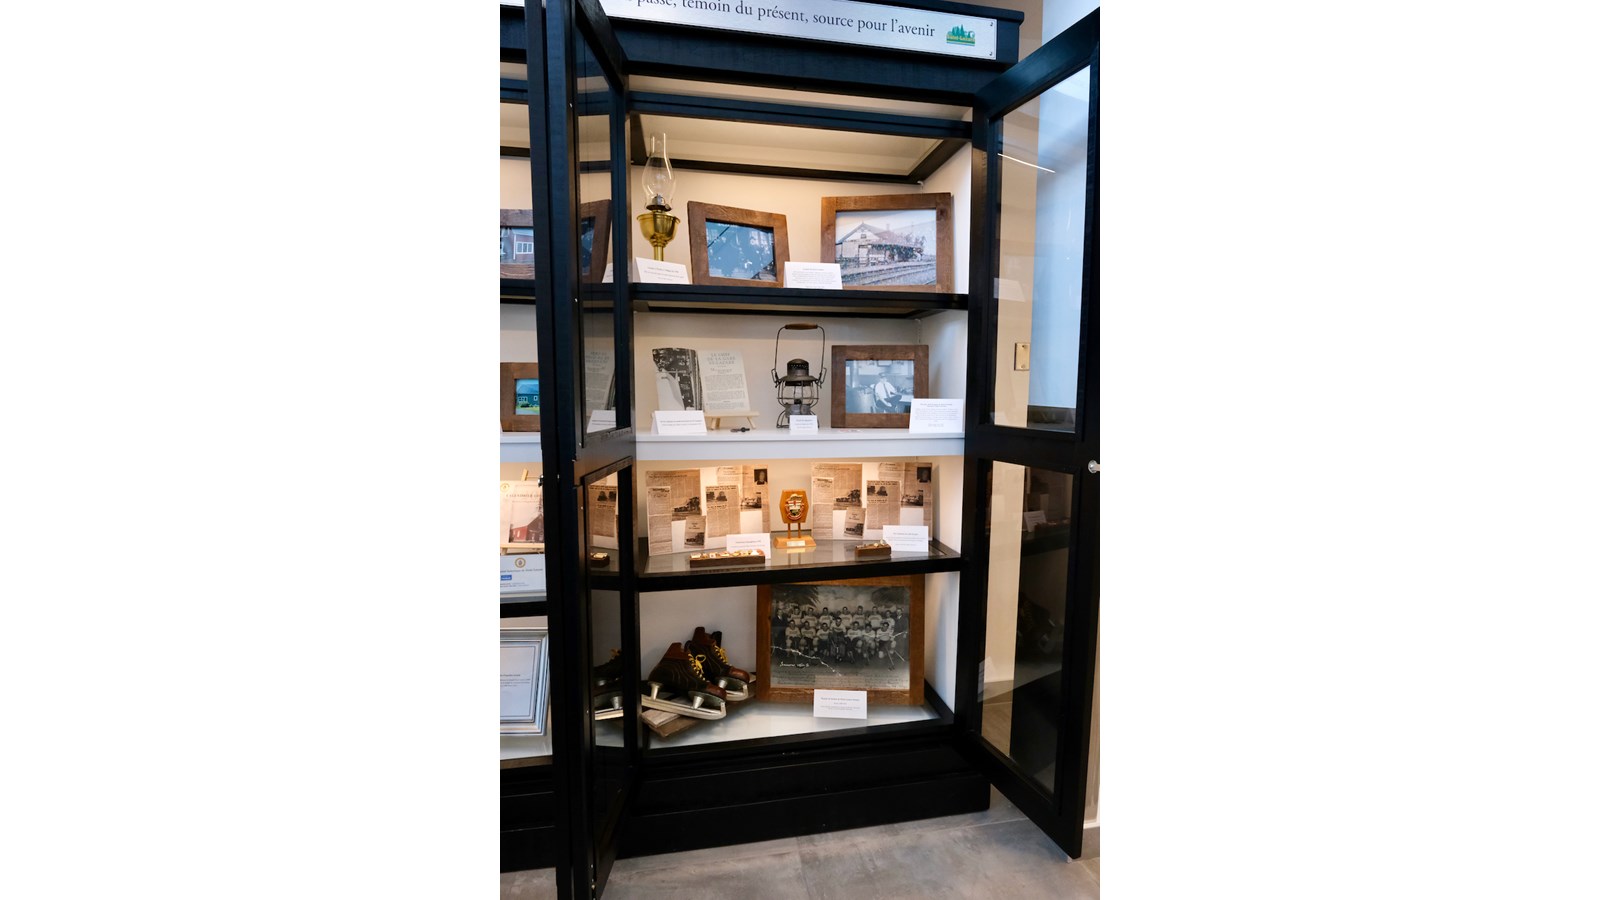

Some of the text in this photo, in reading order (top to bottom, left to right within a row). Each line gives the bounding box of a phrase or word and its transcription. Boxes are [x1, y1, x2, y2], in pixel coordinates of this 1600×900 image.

[735, 0, 753, 15] du
[757, 5, 808, 24] présent,
[812, 14, 854, 28] source
[857, 19, 888, 33] pour
[891, 18, 936, 37] l’avenir
